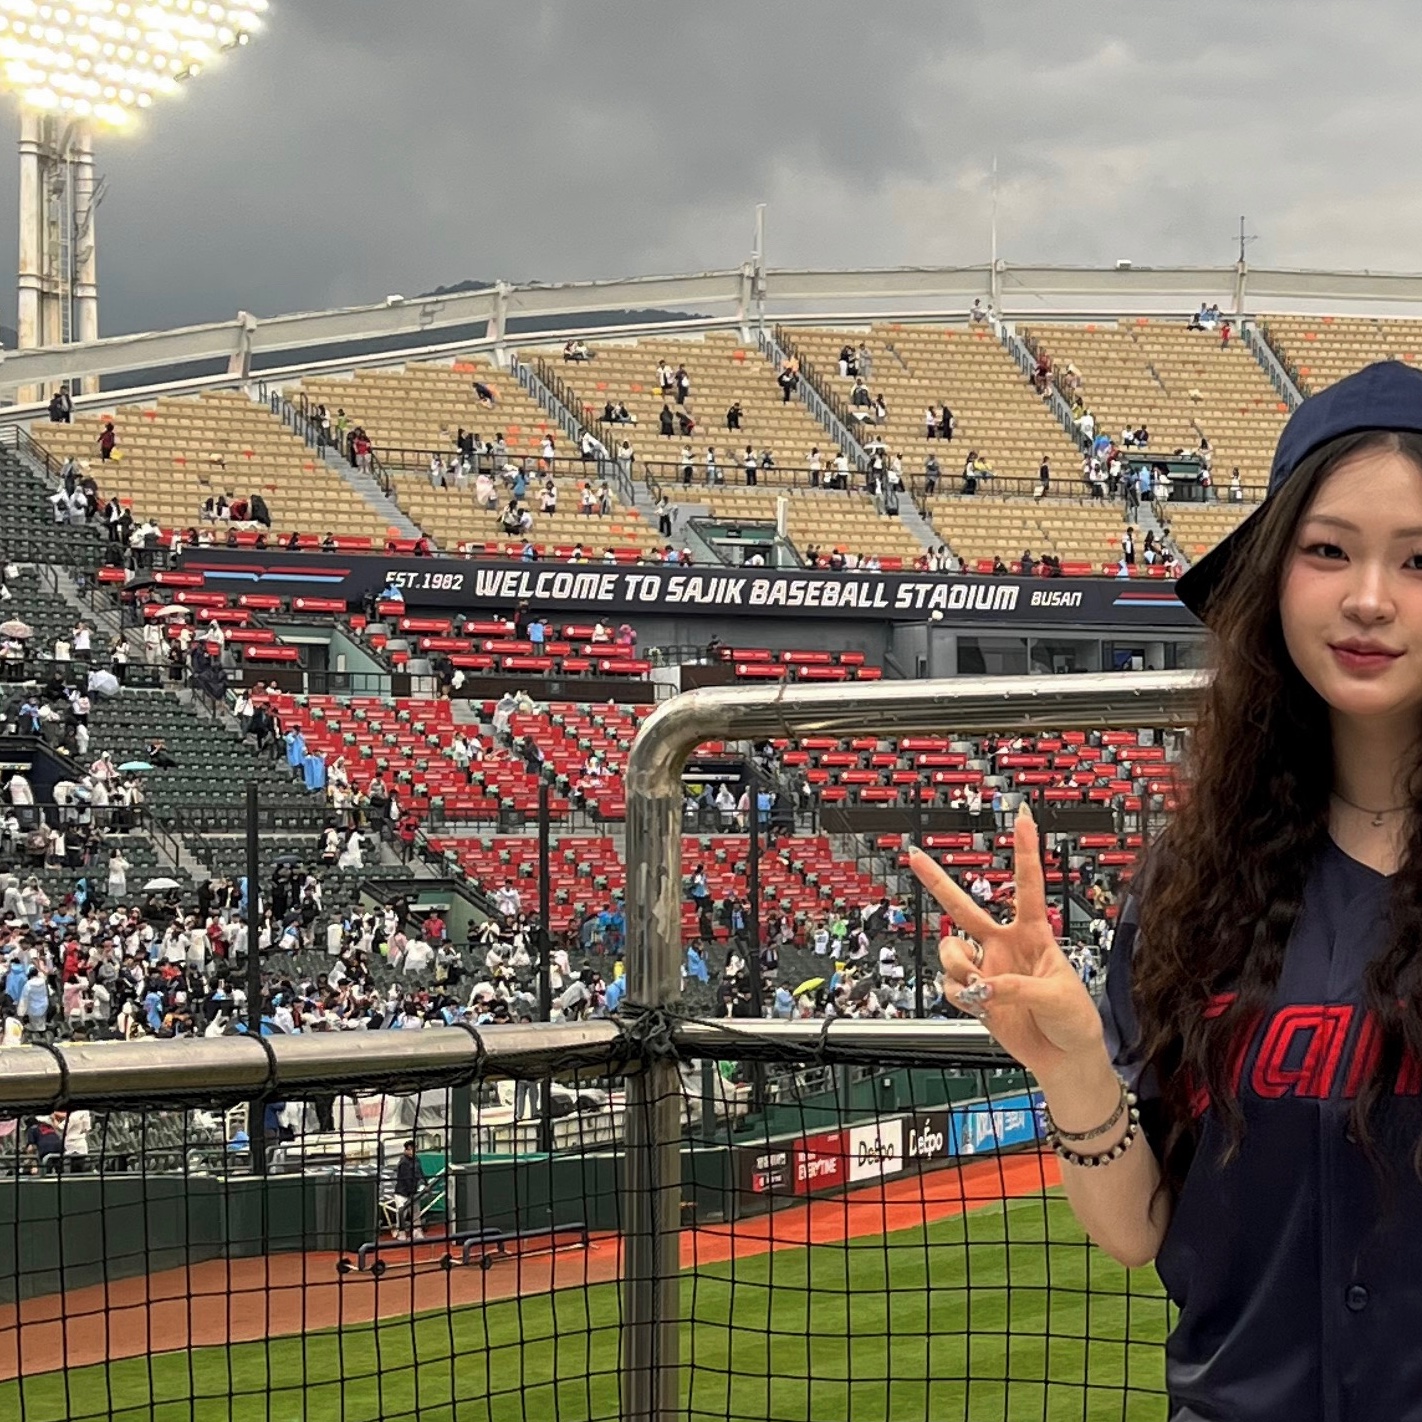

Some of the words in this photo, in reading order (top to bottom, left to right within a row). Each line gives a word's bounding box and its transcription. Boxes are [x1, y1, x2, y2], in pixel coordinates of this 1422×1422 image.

[385, 571, 464, 591] EST.1982
[475, 569, 619, 601] WELCOME
[624, 574, 661, 602] TO
[665, 576, 746, 604] SAJIK
[749, 578, 889, 608] BASEBALL
[895, 582, 1019, 610] STADIUM
[1030, 591, 1082, 607] BUSAN
